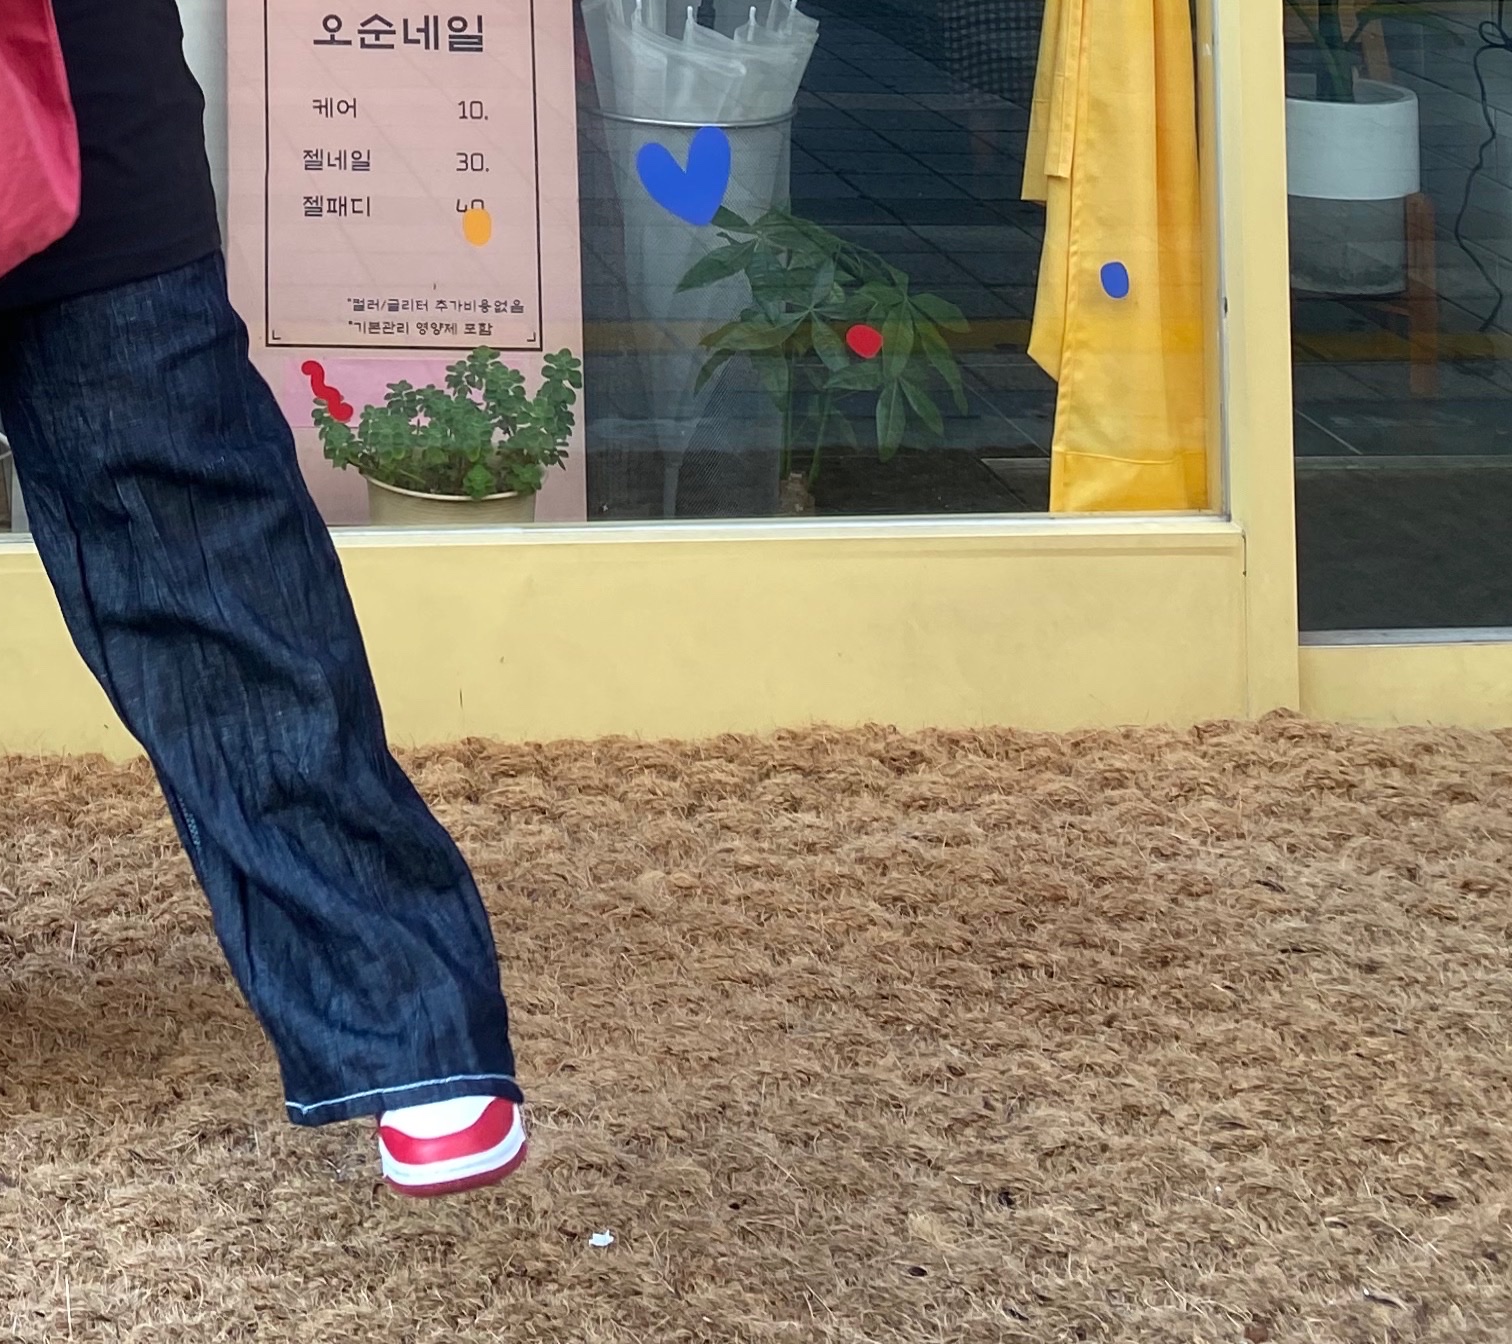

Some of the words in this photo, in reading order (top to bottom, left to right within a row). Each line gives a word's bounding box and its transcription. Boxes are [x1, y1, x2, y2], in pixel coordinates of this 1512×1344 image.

[313, 14, 483, 52] 오순네일
[312, 97, 357, 118] 케어
[457, 100, 489, 121] 10.
[302, 148, 371, 172] 젤네일
[455, 152, 490, 173] 30.
[302, 195, 371, 218] 젤패디
[435, 298, 525, 314] 추가비용없음
[416, 321, 458, 336] 영양제
[464, 322, 494, 336] 포함
